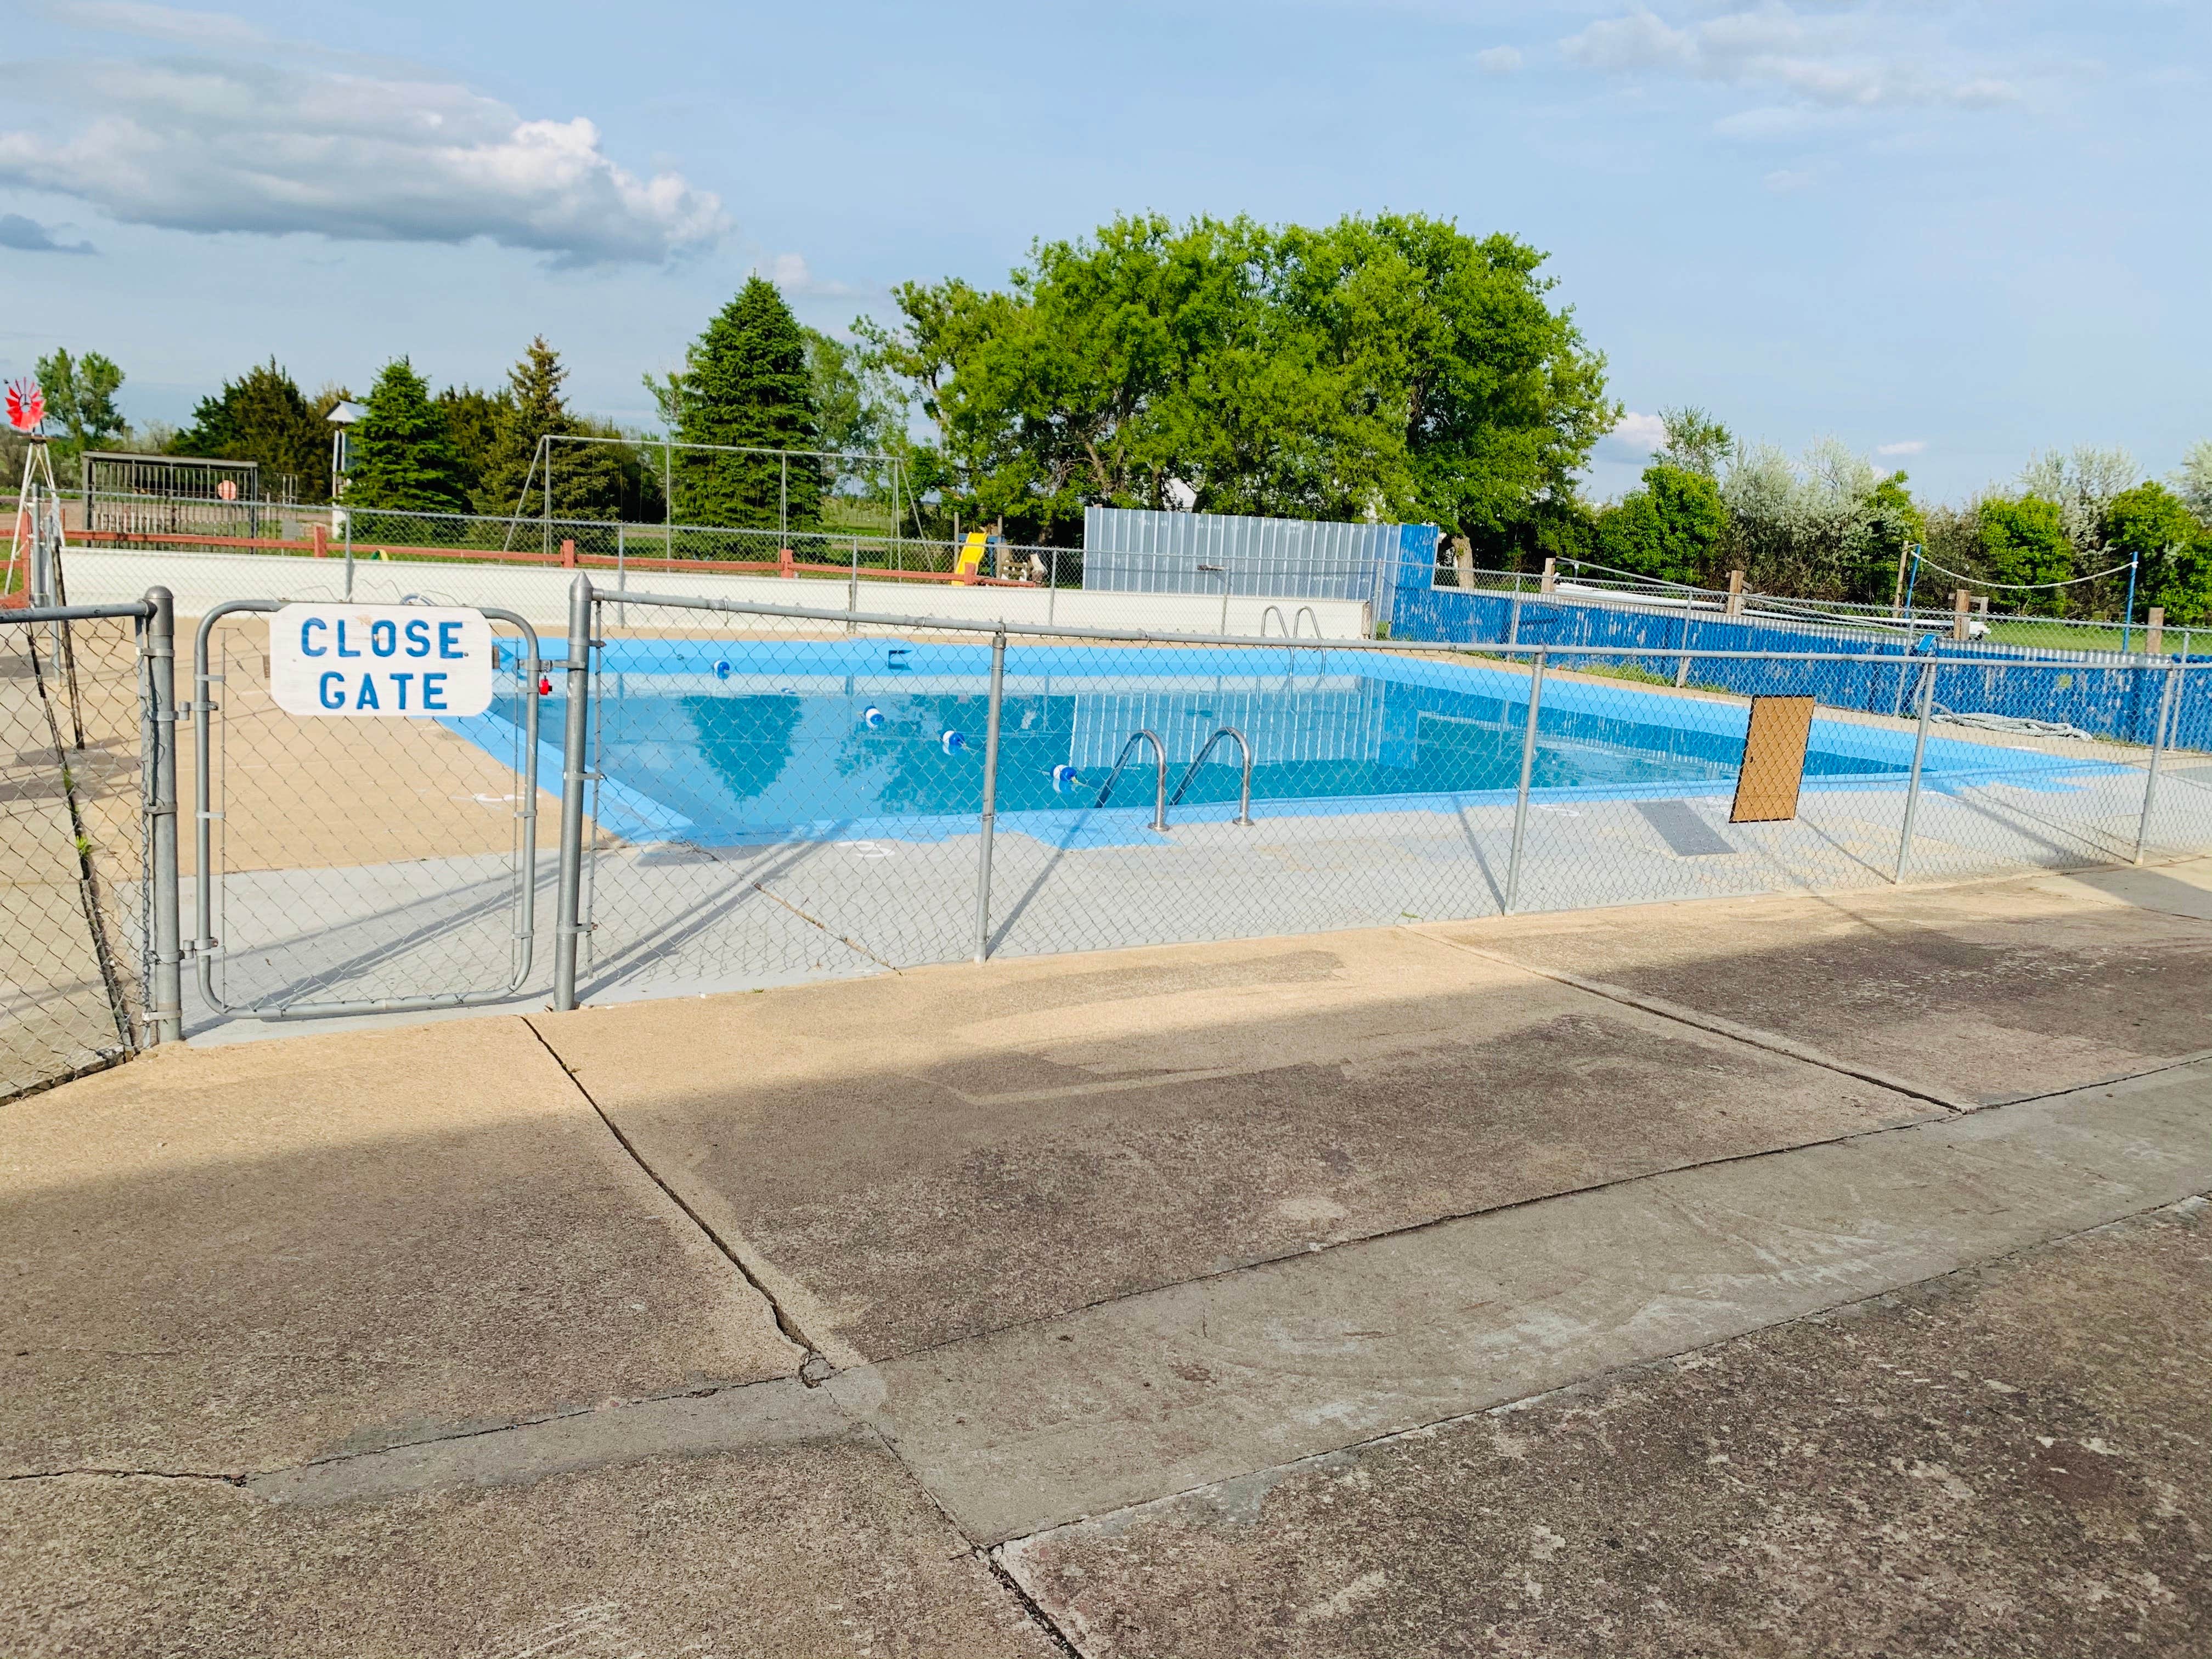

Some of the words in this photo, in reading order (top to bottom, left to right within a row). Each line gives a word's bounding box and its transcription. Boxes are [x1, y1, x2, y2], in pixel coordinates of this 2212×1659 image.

[301, 617, 464, 658] CLOSE
[319, 670, 447, 710] GATE
[837, 840, 895, 857] 3
